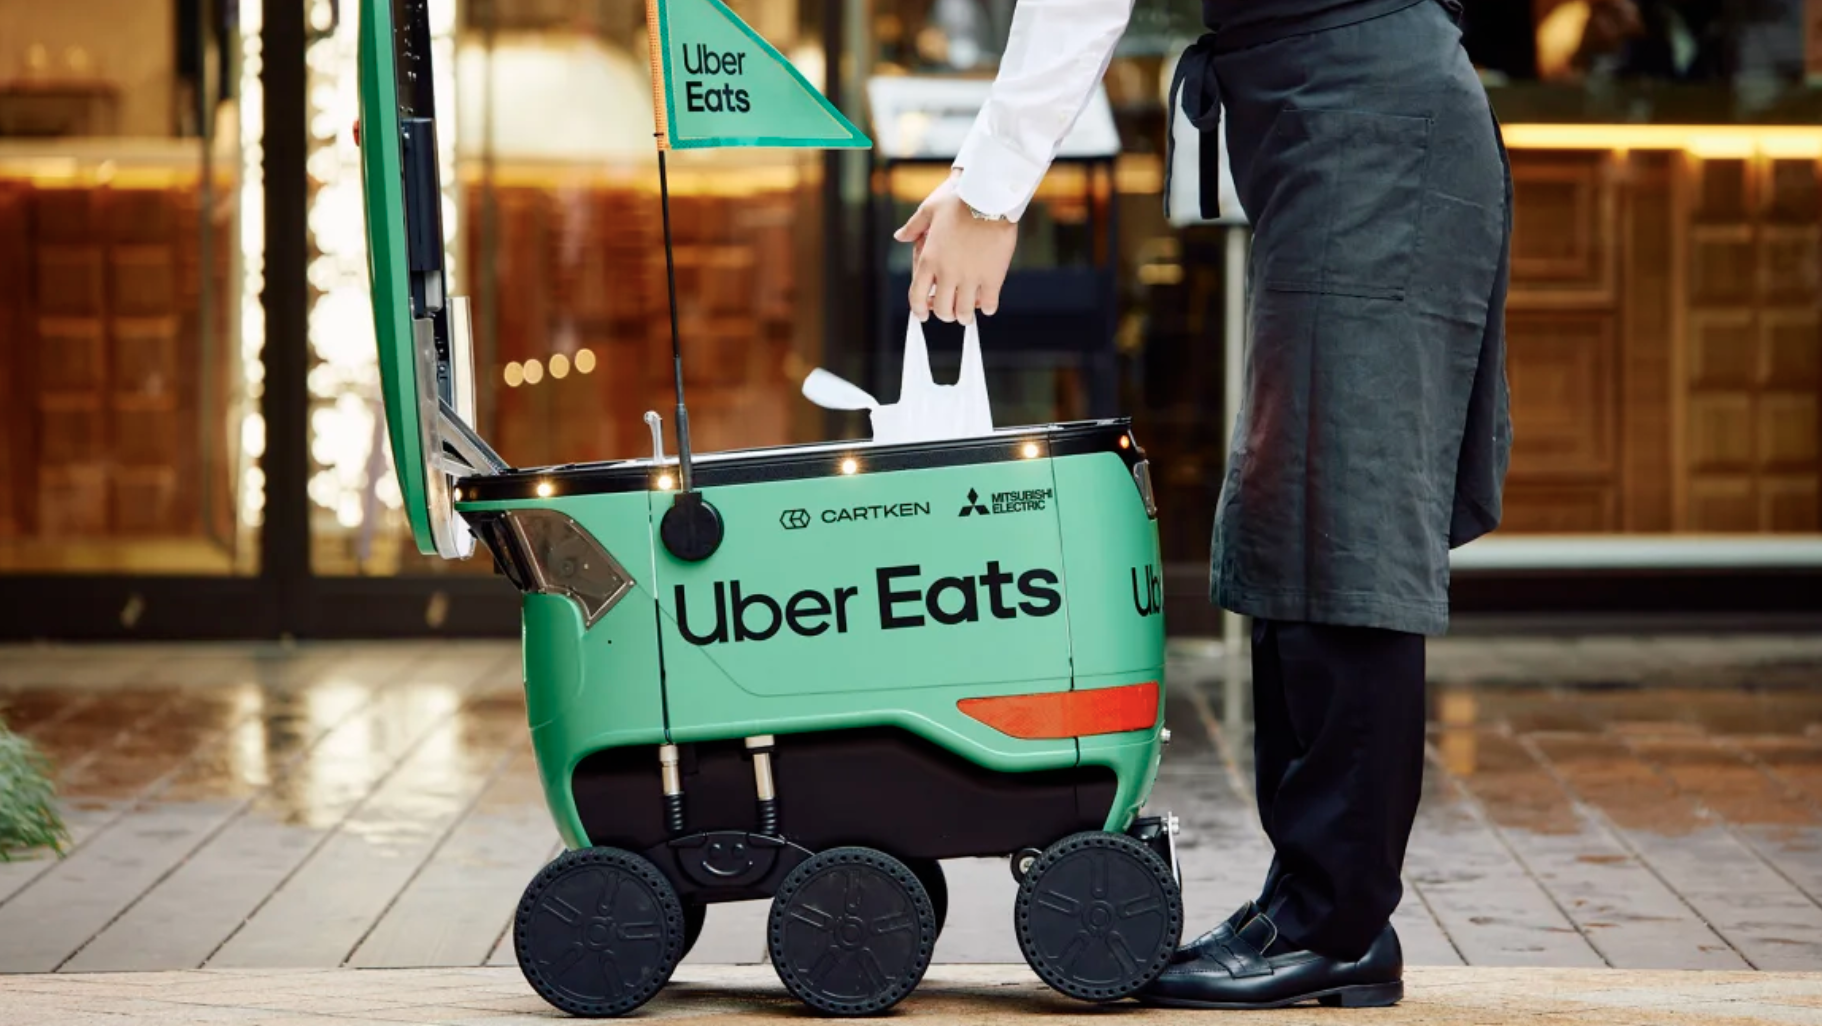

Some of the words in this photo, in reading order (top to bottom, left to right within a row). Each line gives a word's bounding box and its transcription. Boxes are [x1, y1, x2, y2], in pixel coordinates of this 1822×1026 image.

[682, 43, 746, 75] Uber
[685, 81, 751, 113] Eats
[991, 488, 1053, 504] MITSUBISHI
[992, 500, 1046, 515] ELECTRIC
[820, 501, 931, 524] CARTKEN
[674, 579, 858, 646] Uber
[875, 560, 1062, 630] Eats
